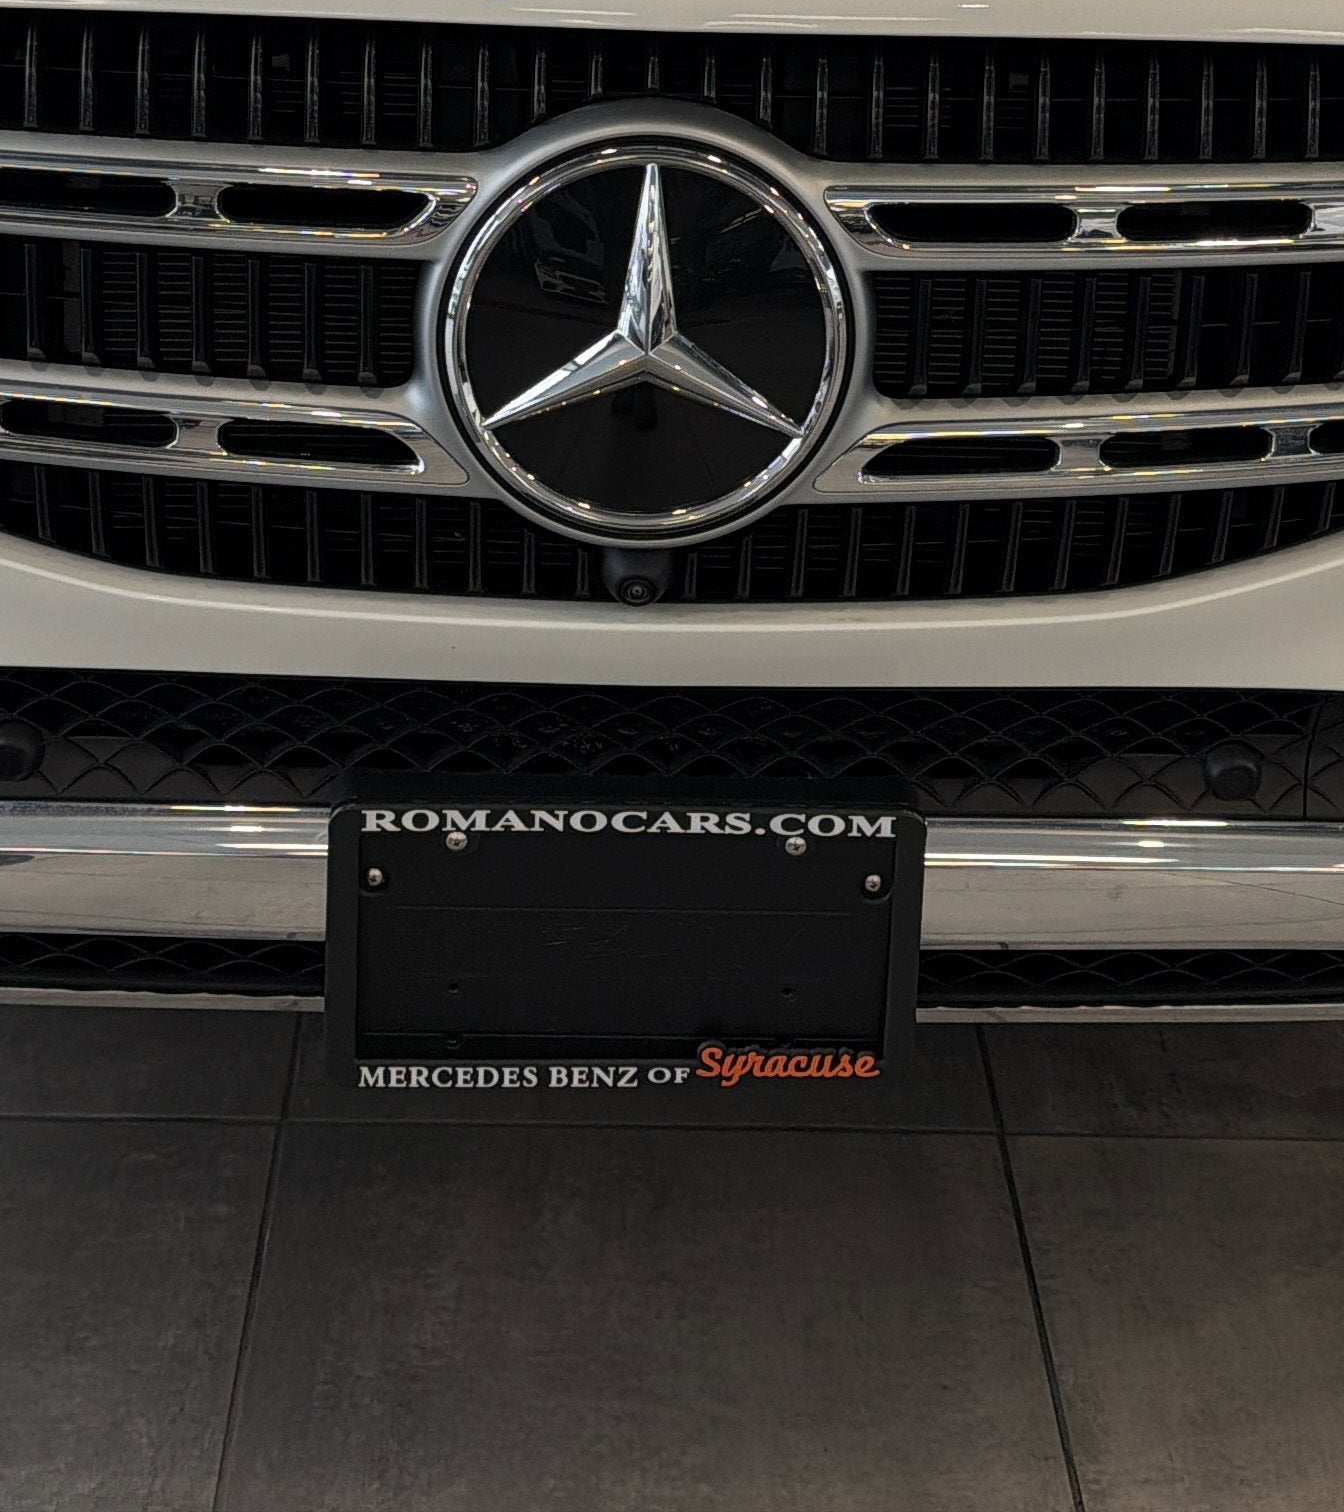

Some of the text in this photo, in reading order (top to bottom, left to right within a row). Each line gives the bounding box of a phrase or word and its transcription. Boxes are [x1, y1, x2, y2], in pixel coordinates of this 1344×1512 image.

[361, 809, 897, 838] ROMANOCARS.COM
[357, 1046, 881, 1088] MERCEDES BENZ OF Syracuse
